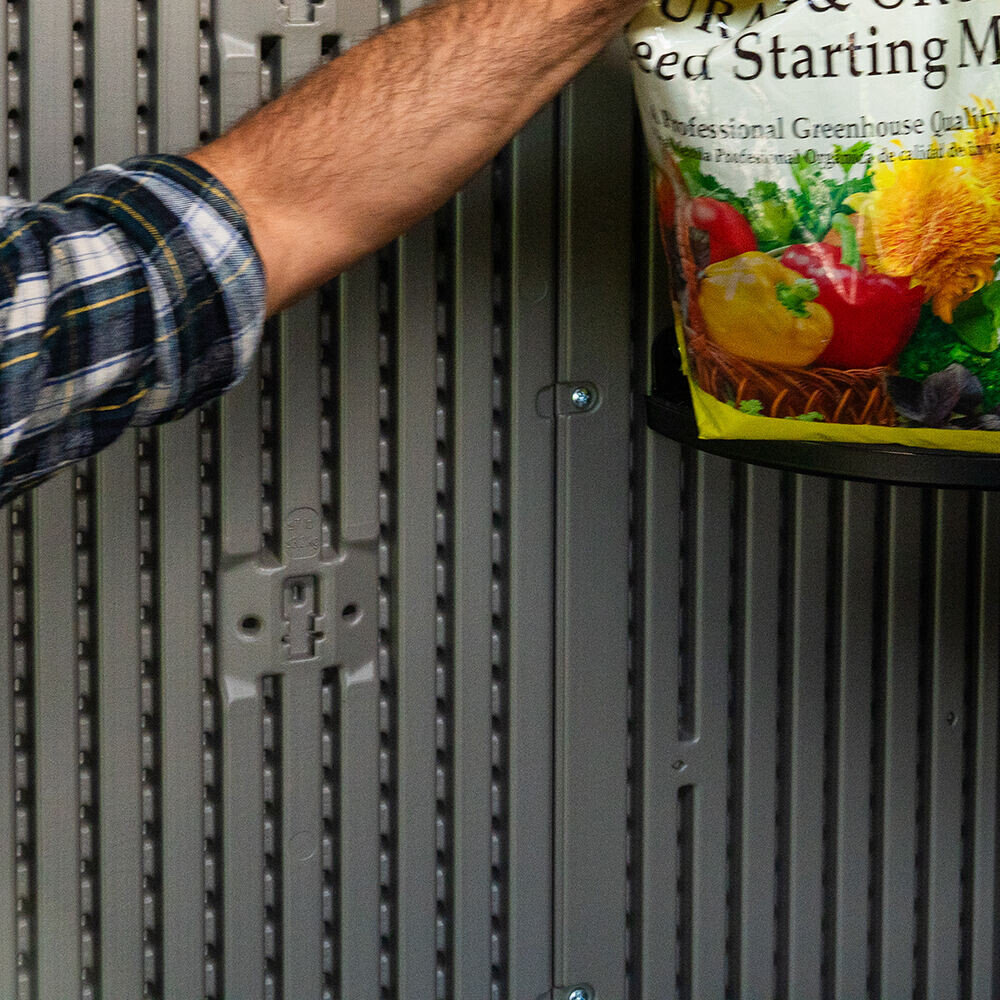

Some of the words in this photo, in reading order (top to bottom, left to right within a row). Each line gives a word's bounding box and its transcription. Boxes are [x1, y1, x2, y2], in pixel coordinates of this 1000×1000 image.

[733, 26, 948, 90] Starting
[661, 108, 785, 140] Professional
[792, 116, 925, 140] Greenhouse
[929, 106, 1000, 137] Quality
